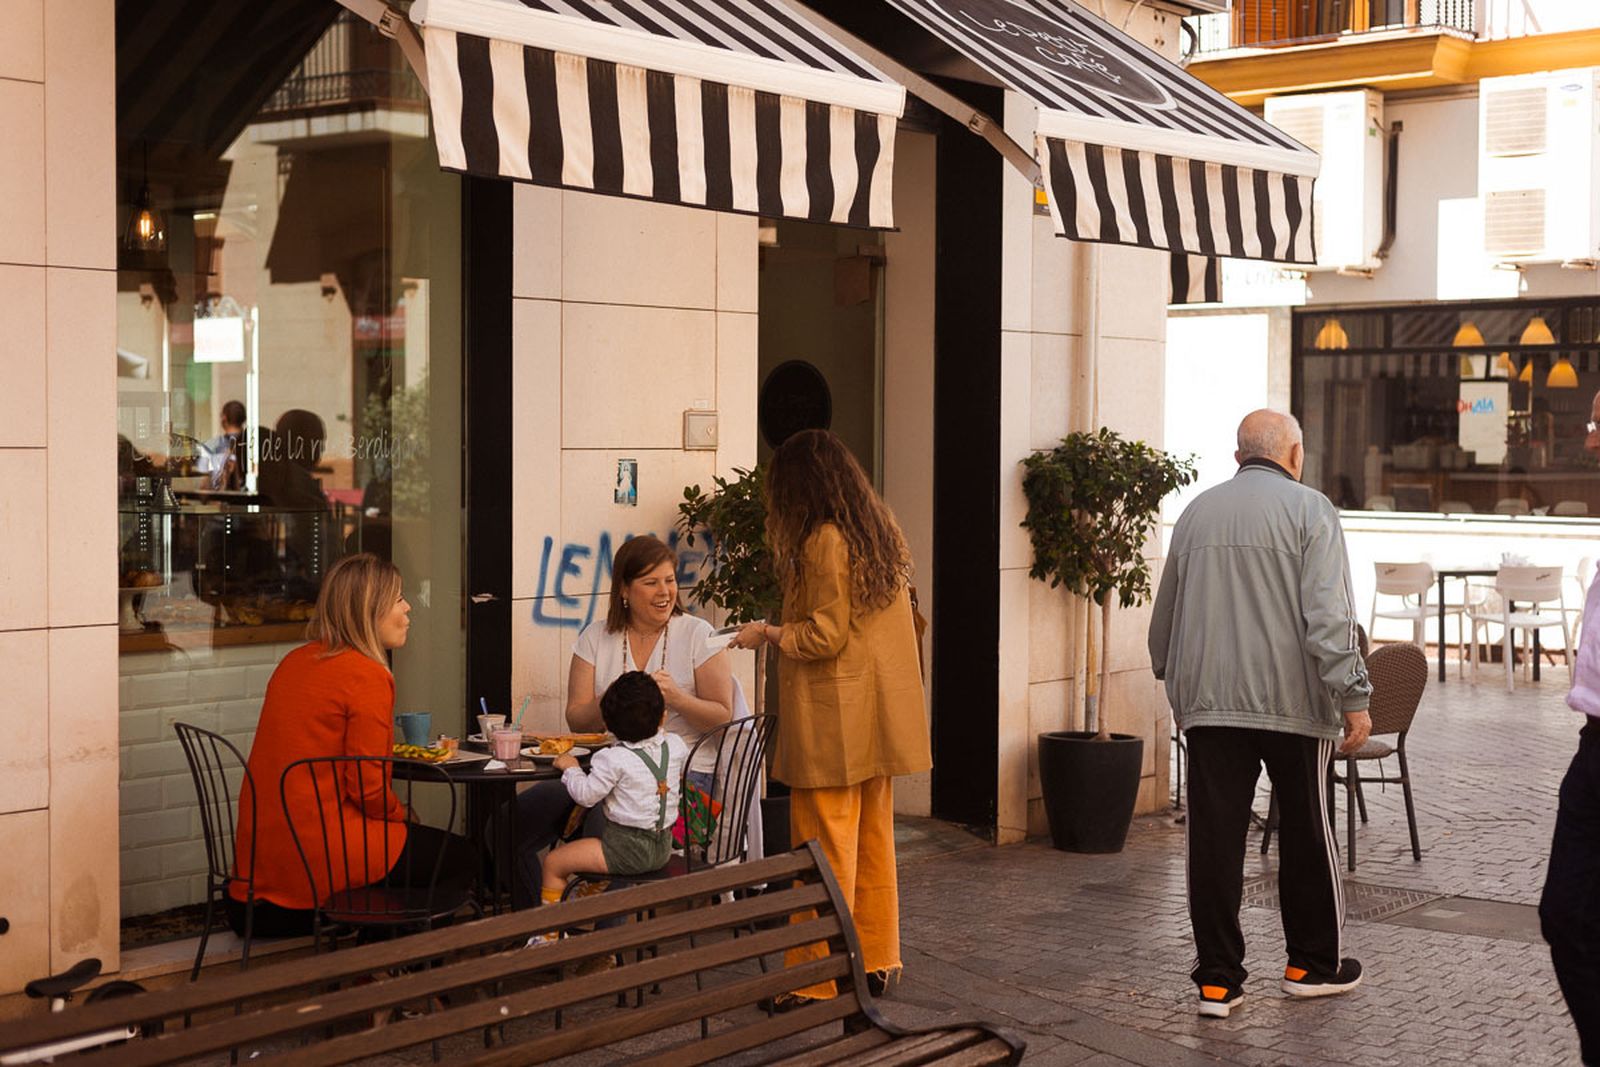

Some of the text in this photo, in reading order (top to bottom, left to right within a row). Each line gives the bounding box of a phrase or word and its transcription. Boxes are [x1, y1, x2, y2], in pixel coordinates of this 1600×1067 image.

[1035, 46, 1122, 85] Café
[262, 429, 282, 462] de
[287, 429, 305, 461] la
